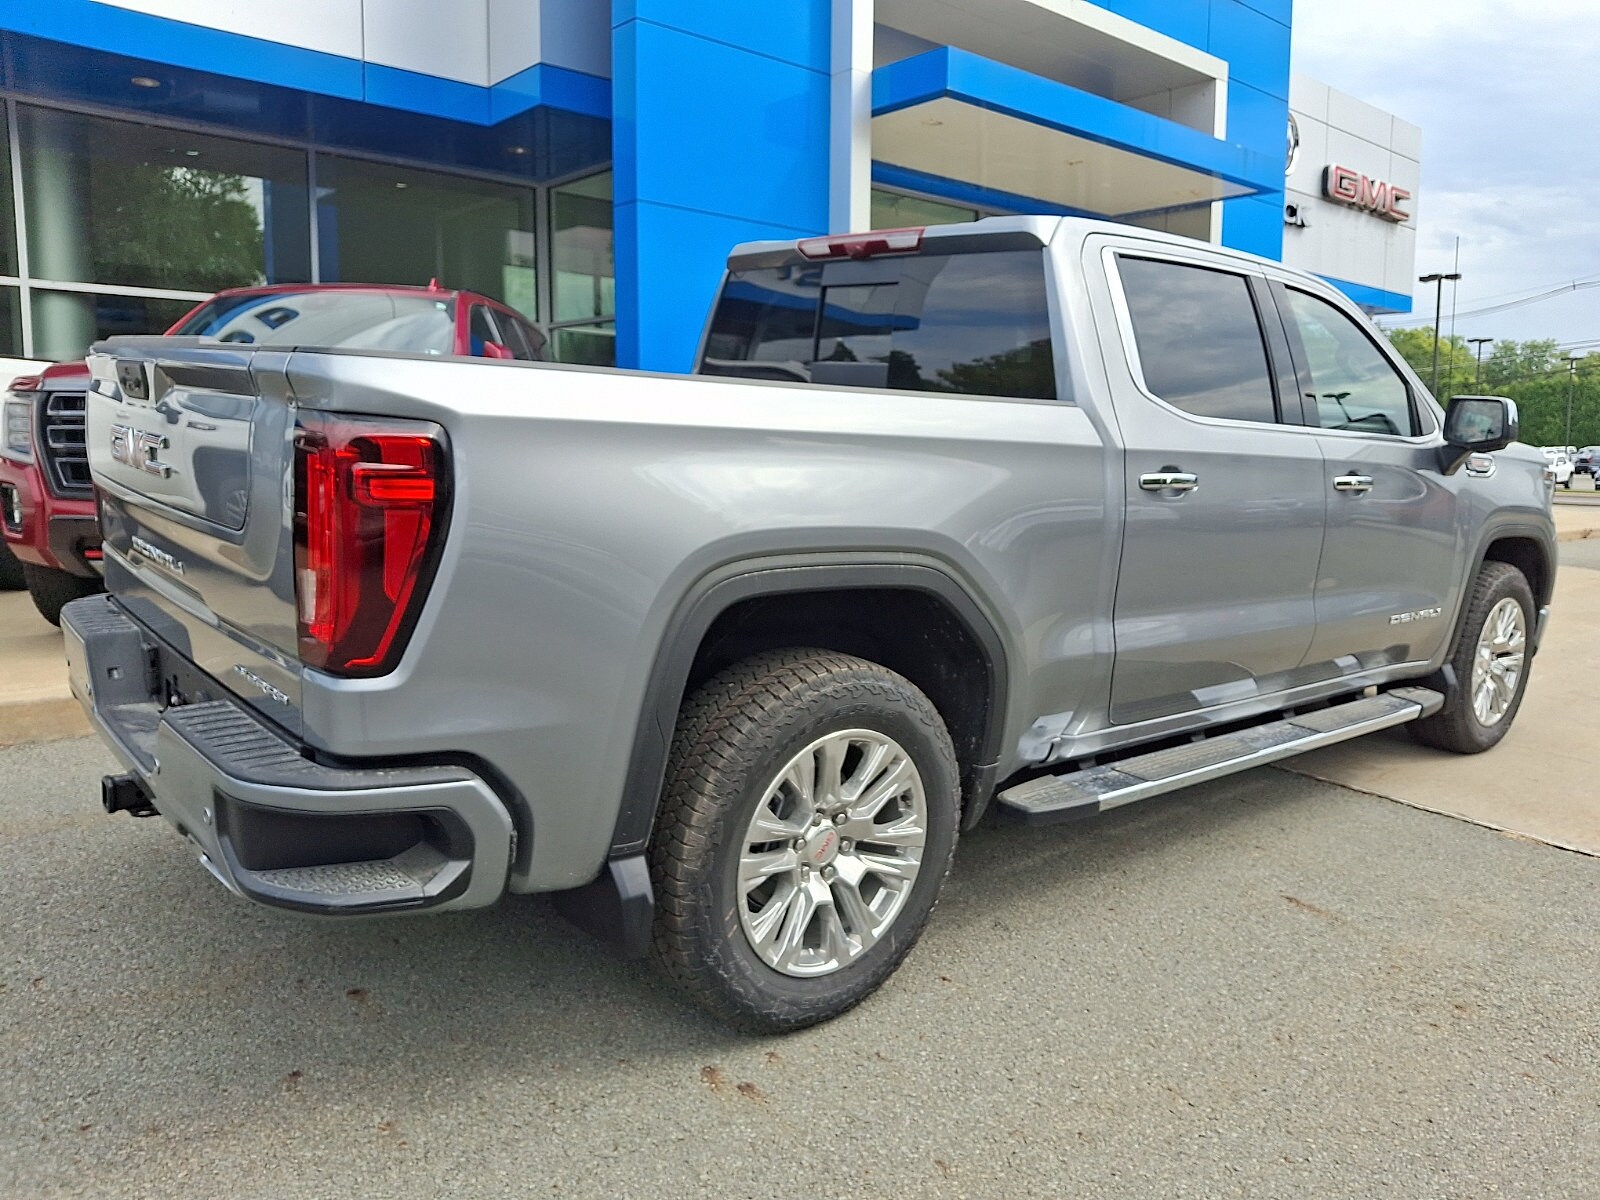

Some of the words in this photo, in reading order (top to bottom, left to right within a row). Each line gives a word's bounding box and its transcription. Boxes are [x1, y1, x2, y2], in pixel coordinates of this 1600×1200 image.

[1325, 165, 1410, 222] GMC
[111, 424, 171, 479] GMC
[1389, 607, 1441, 624] DENALI
[815, 831, 835, 861] GMC
